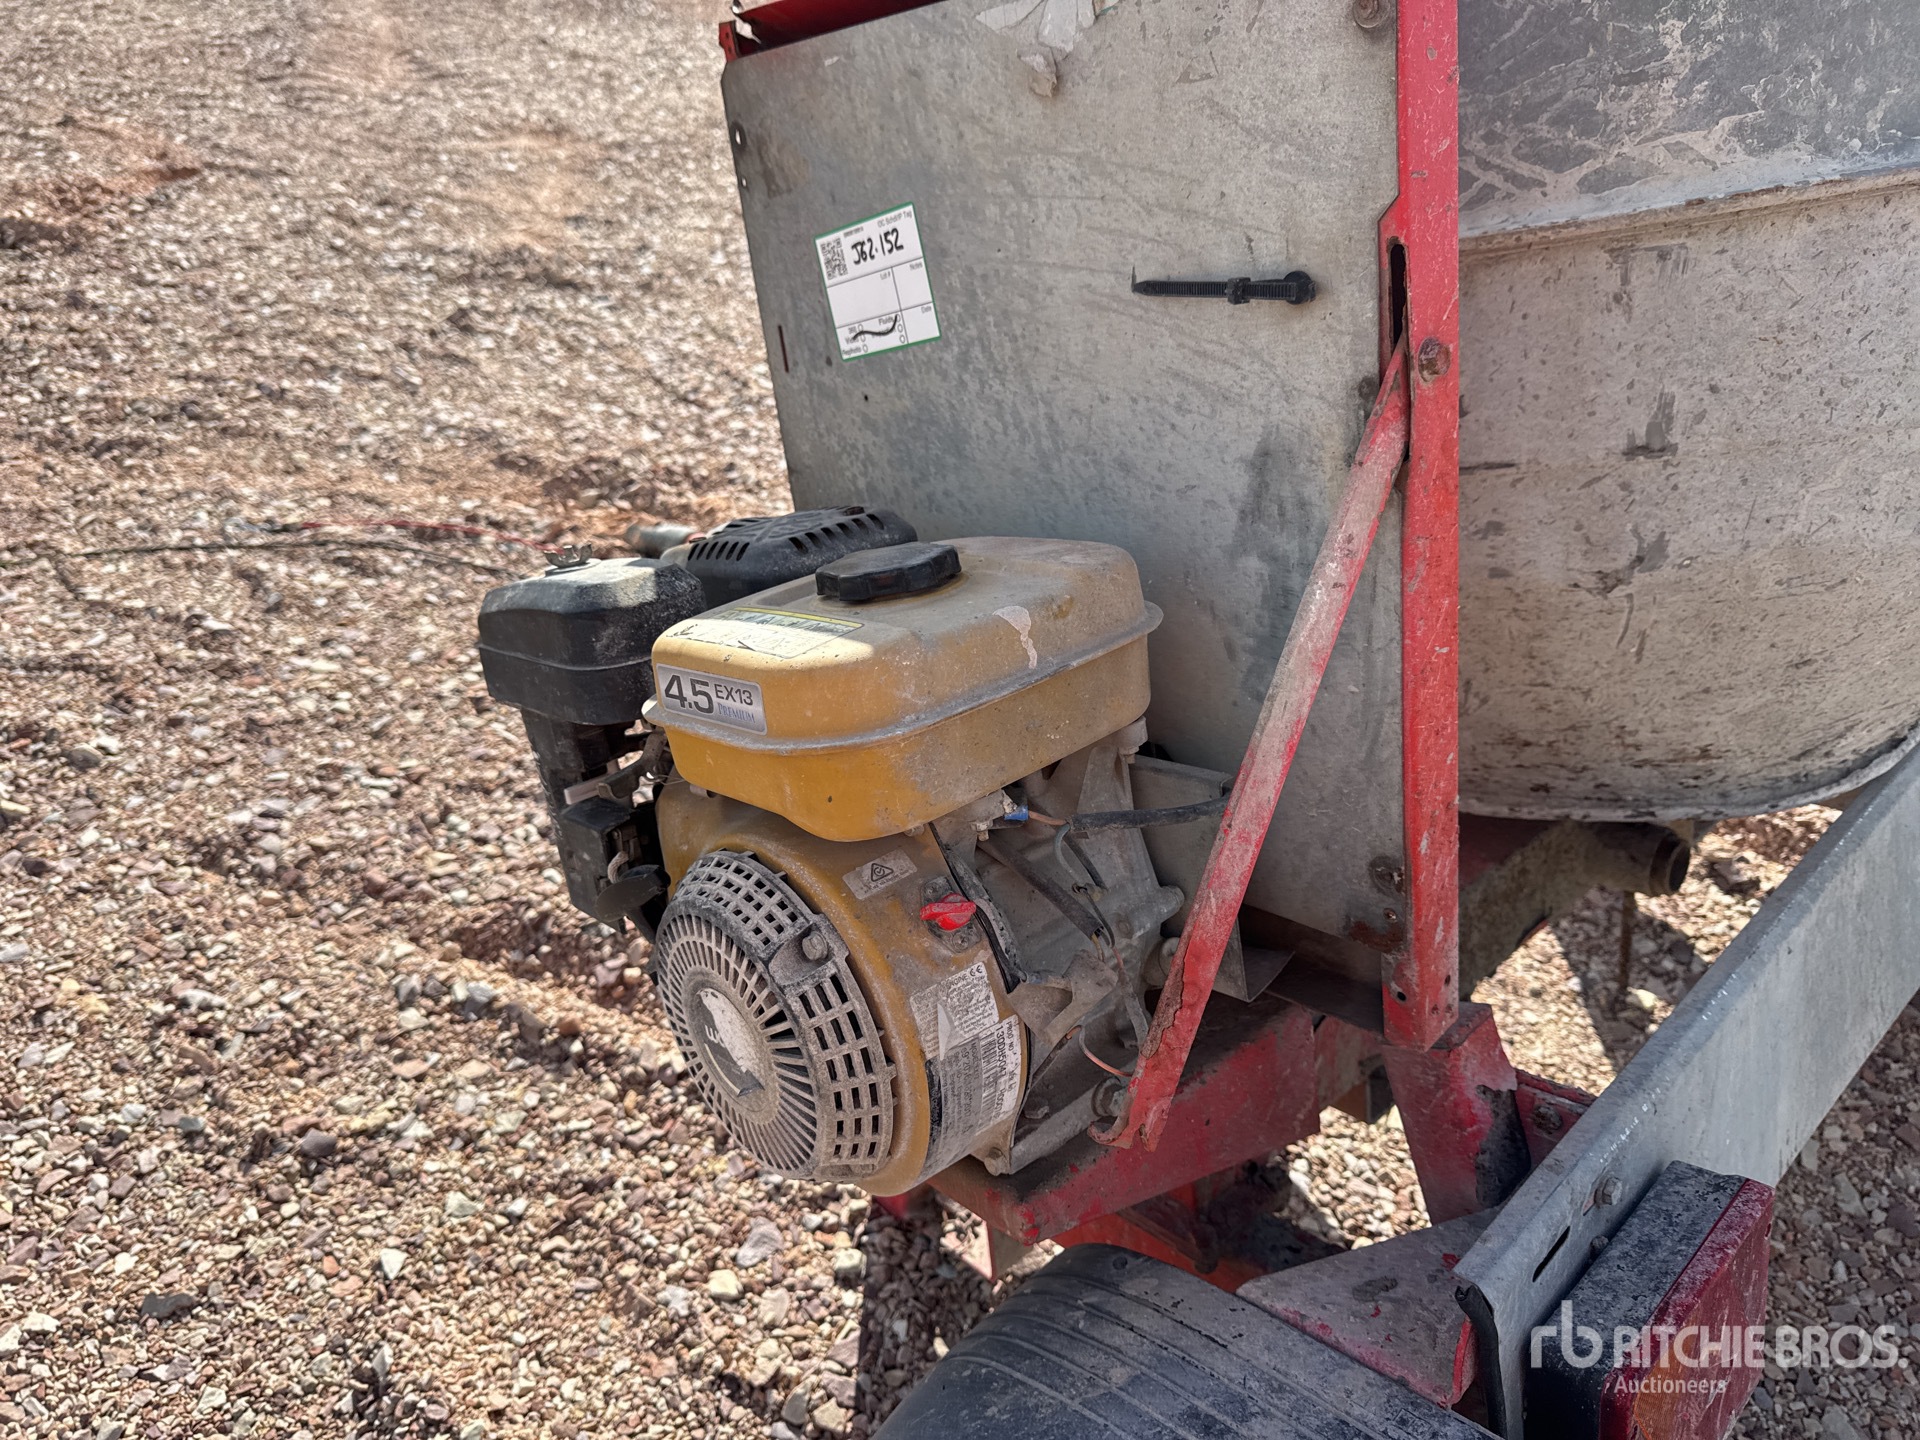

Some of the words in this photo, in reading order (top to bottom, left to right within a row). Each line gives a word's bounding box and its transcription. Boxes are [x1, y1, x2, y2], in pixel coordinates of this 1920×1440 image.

[664, 674, 714, 714] 4.5
[714, 683, 754, 706] EX13
[717, 702, 756, 723] PREMIUM
